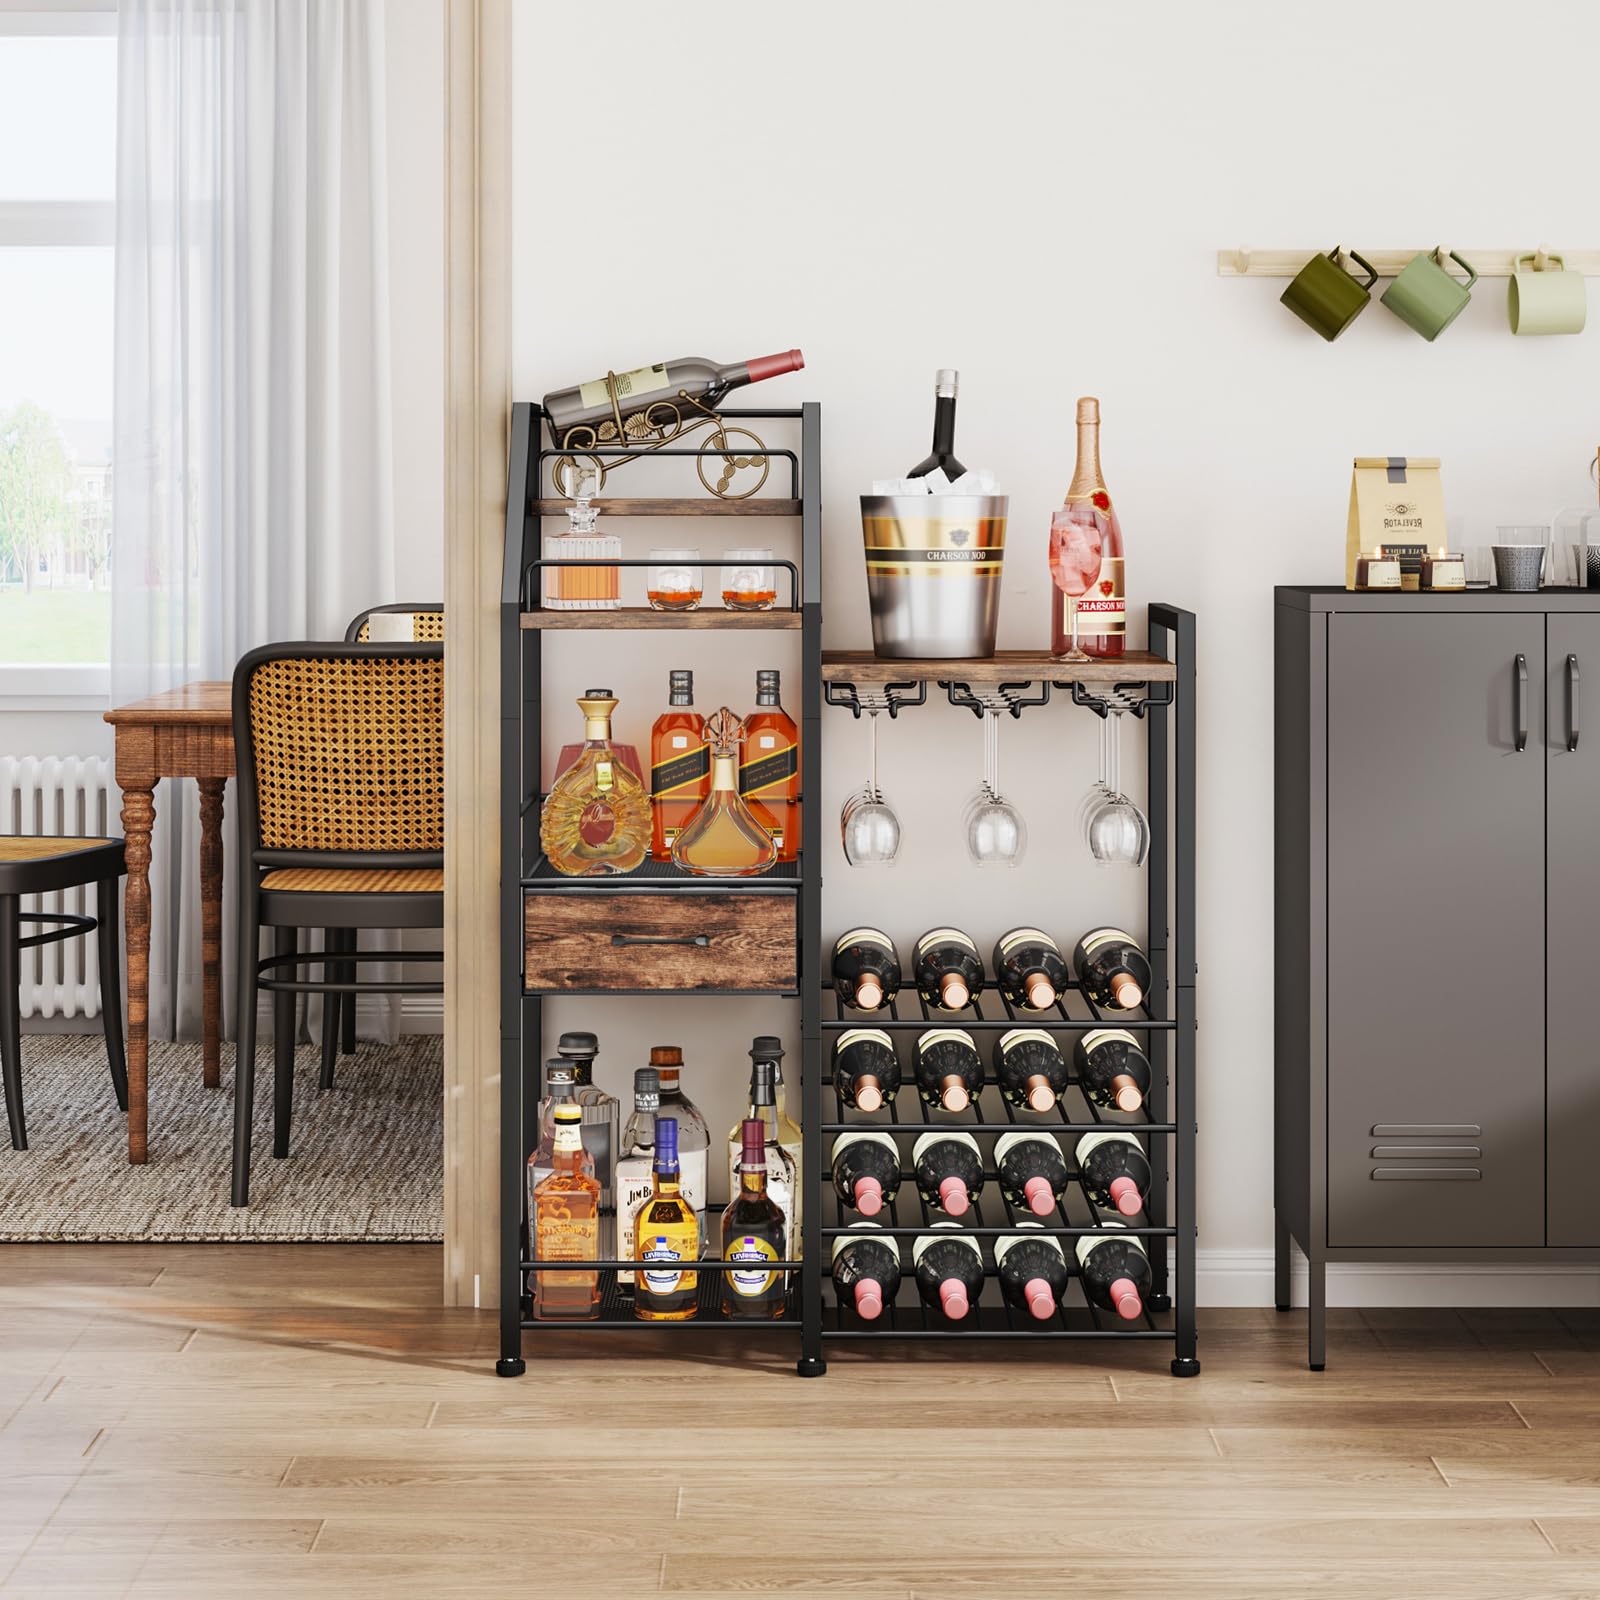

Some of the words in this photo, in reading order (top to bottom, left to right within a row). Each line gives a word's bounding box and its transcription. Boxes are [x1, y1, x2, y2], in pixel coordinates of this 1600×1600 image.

[926, 551, 969, 560] CHARSON
[971, 551, 986, 560] NOD
[1077, 602, 1114, 611] CHARSON
[627, 1189, 642, 1206] JIM
